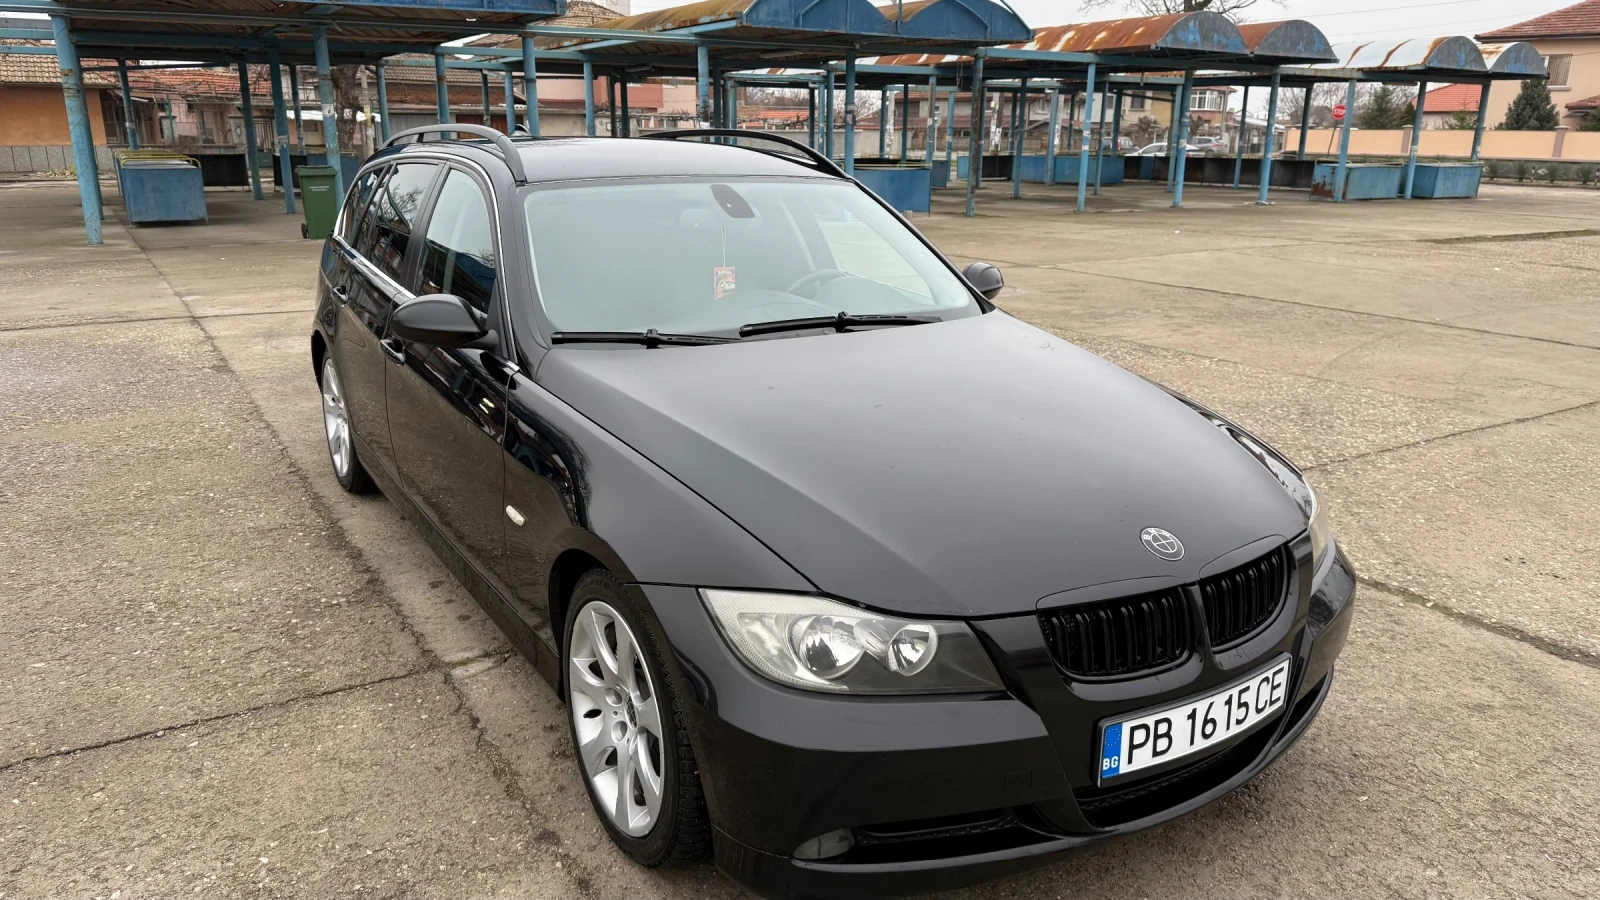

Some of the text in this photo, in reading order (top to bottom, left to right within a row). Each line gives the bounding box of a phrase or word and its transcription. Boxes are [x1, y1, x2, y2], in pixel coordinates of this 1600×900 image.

[1127, 666, 1285, 765] PB 1615 CE
[1102, 756, 1119, 771] BG
